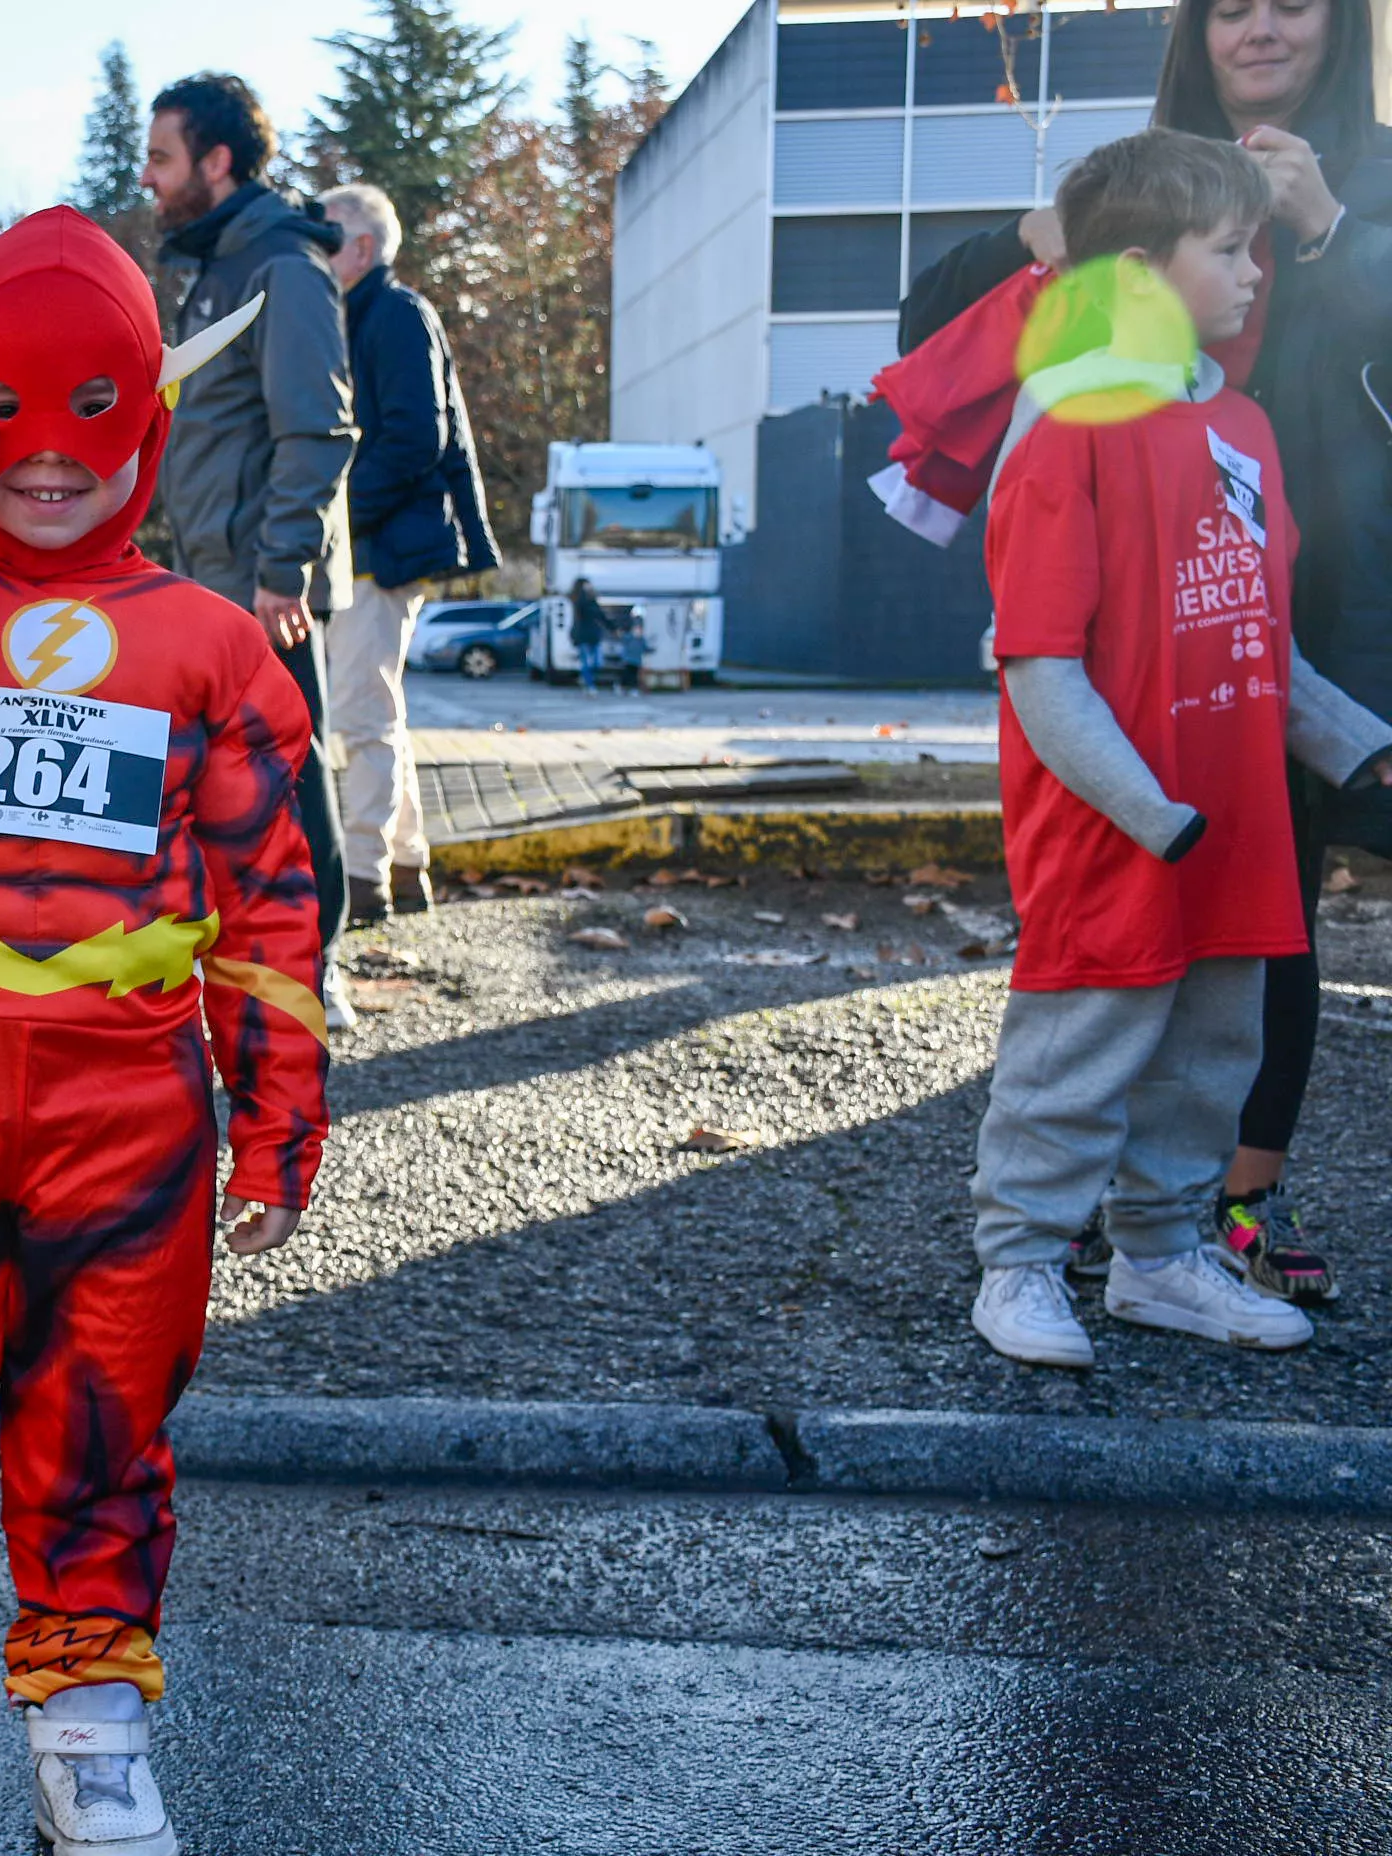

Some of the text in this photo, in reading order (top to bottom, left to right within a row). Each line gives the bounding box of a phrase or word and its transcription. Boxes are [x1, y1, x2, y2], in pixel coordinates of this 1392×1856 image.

[29, 696, 108, 719] SILVESTRE
[0, 727, 7, 735] y
[20, 709, 86, 732] XLIV
